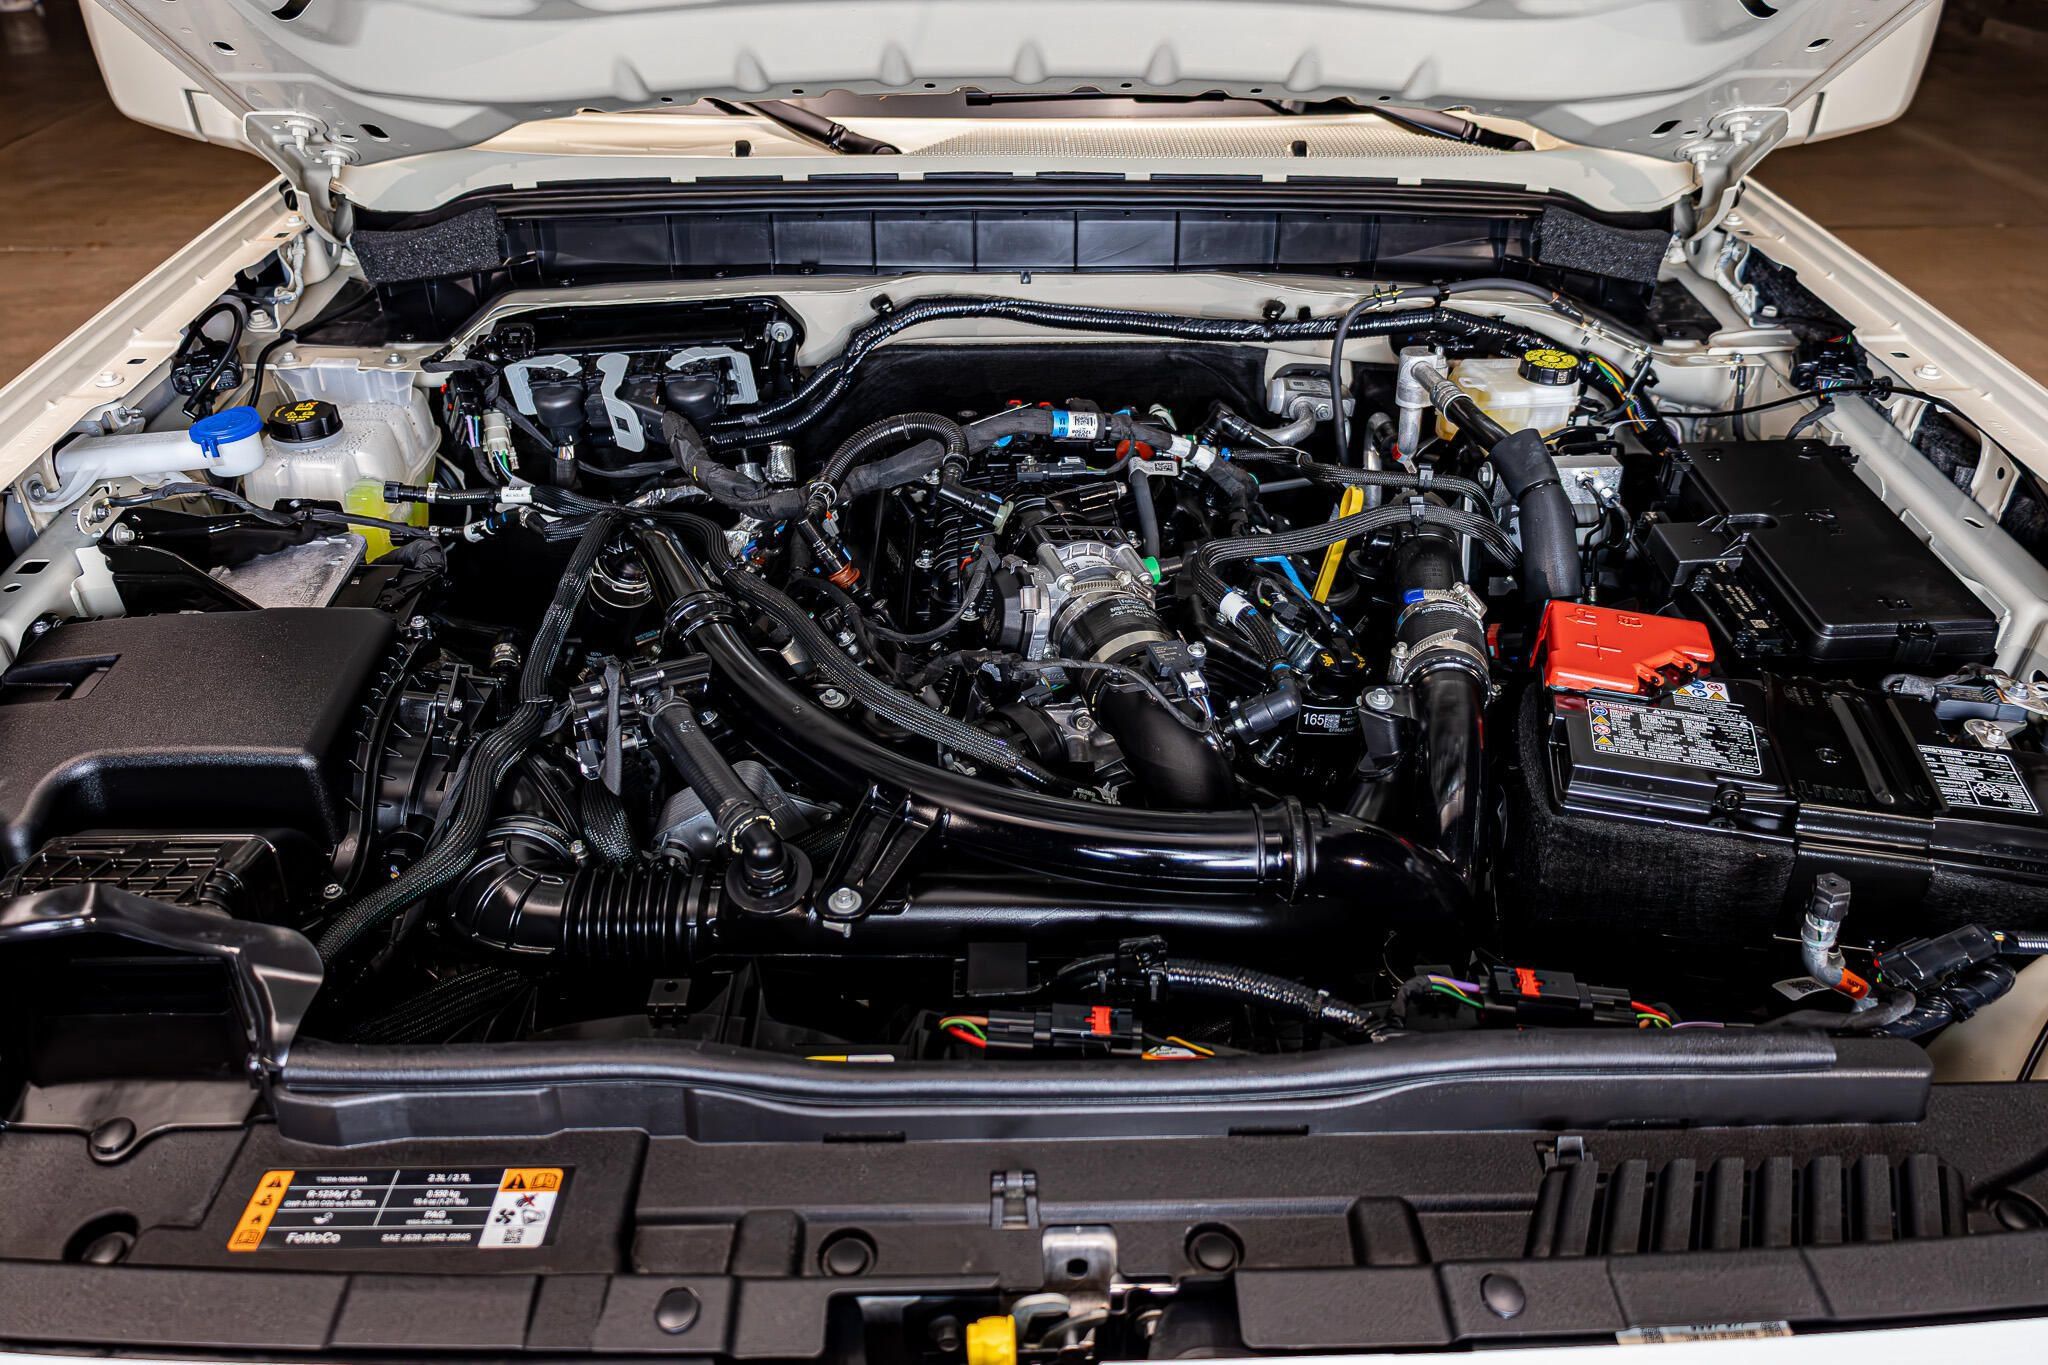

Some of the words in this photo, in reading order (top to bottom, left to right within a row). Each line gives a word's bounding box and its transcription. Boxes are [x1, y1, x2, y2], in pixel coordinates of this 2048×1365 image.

[1303, 712, 1325, 726] 165
[423, 1210, 447, 1219] PAG
[285, 1232, 341, 1245] FoMoCo
[381, 1233, 401, 1243] SAE
